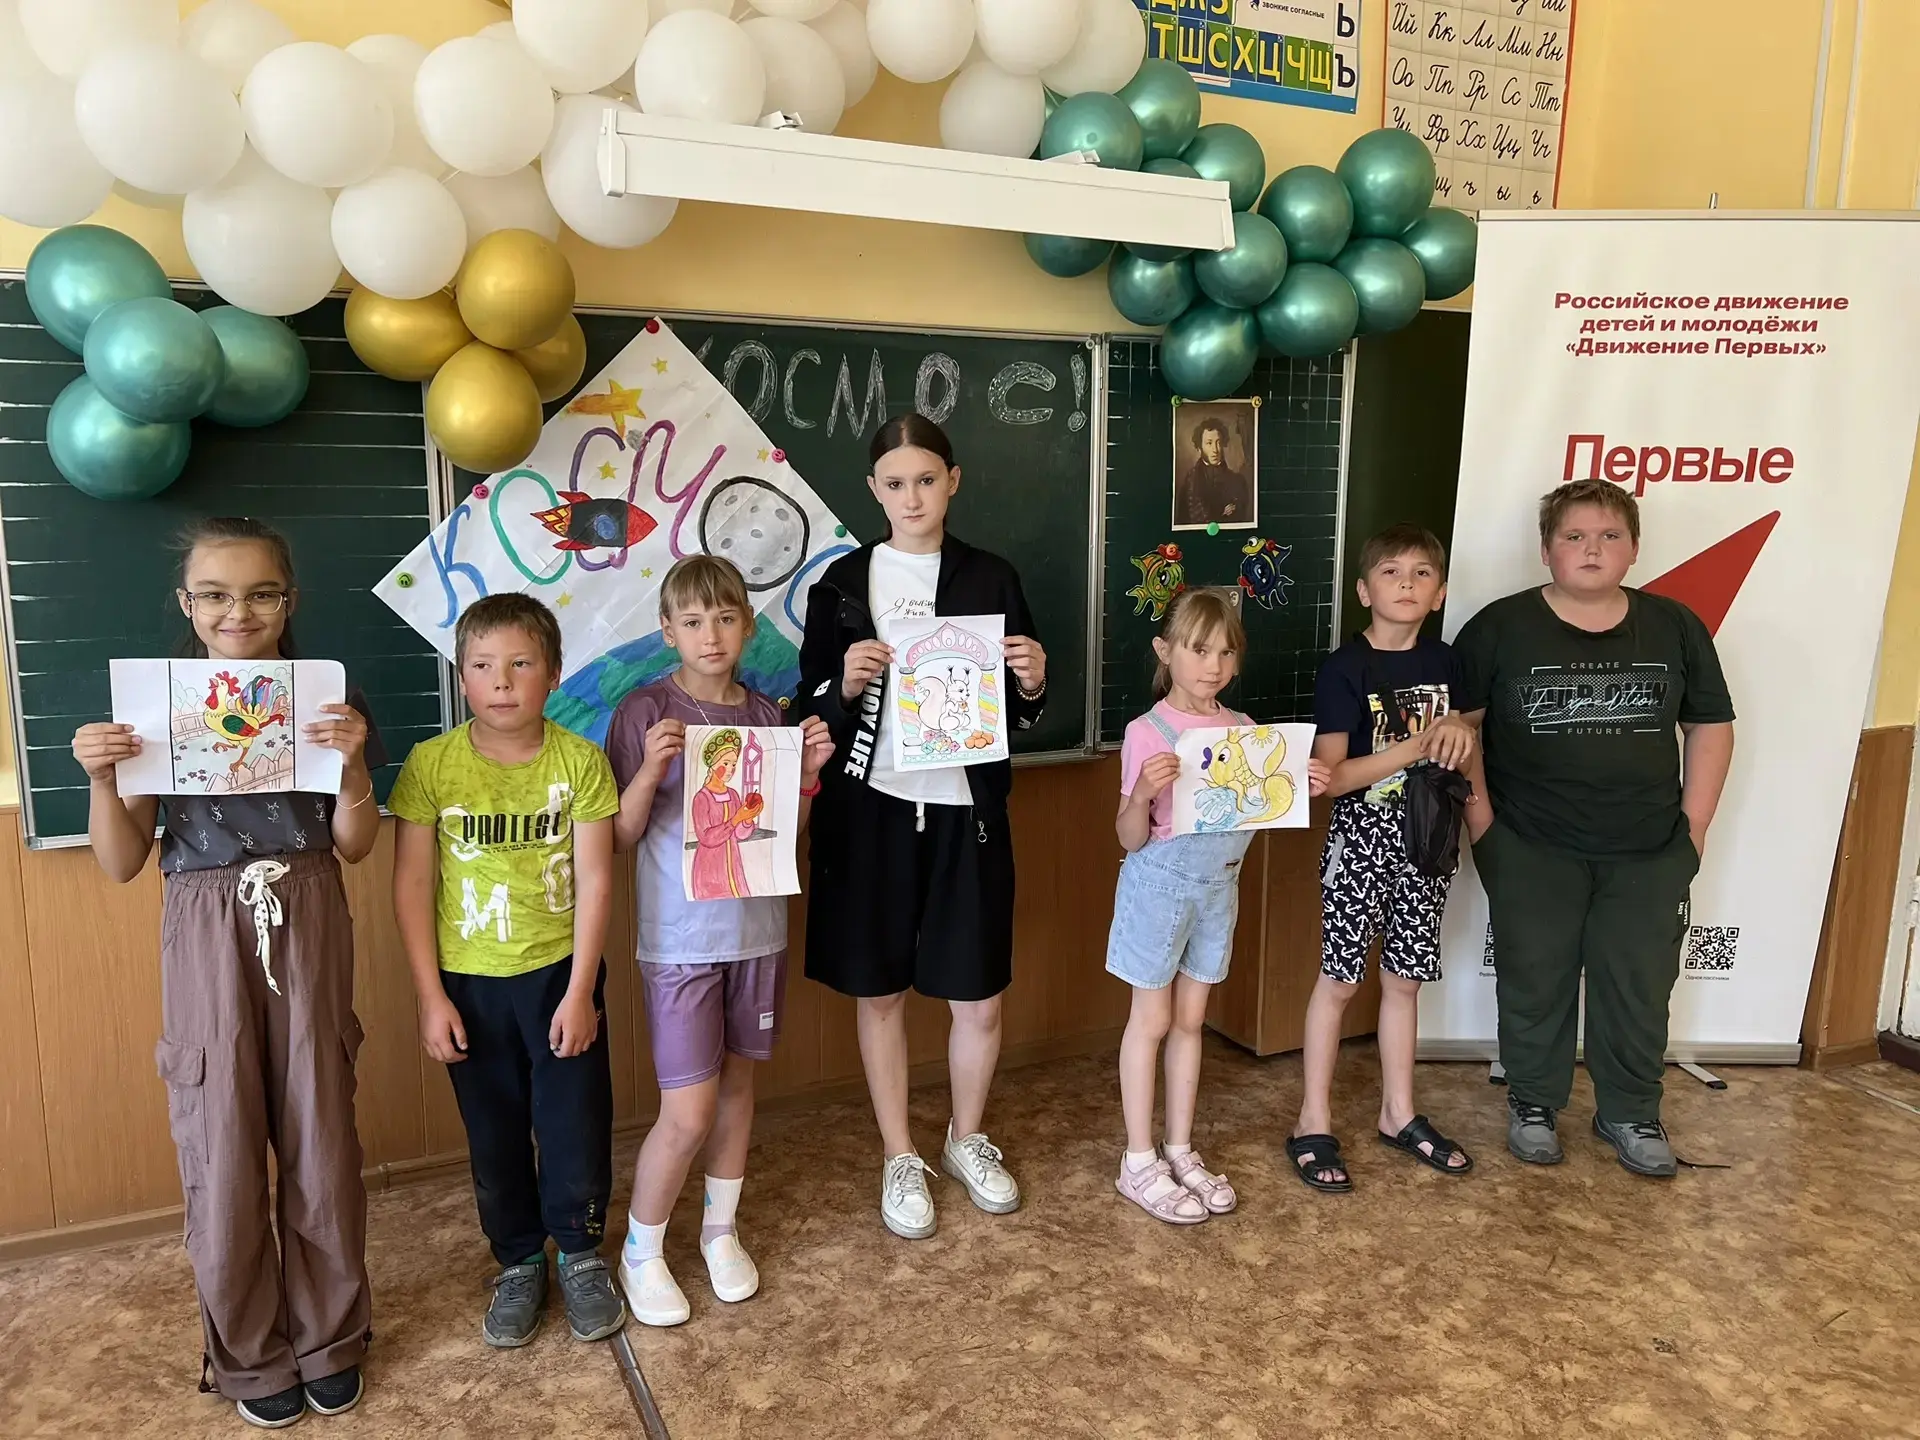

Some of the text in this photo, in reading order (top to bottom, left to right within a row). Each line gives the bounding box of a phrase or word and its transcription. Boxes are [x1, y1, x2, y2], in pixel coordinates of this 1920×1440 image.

[1262, 1, 1325, 19] ЗВОНКИЕ СОГЛАСНЫЕ
[1428, 11, 1456, 42] Кк
[1462, 19, 1495, 50] Лл
[1498, 25, 1532, 57] Мм
[1535, 31, 1564, 62] Нн
[1392, 57, 1561, 112] Оо Пп Рр Сс Тт
[1423, 113, 1450, 154] Фф
[1456, 119, 1487, 149] Хх
[1492, 123, 1522, 159] Цц
[1532, 129, 1551, 159] Чч
[1554, 292, 1849, 312] Российское движение
[1579, 314, 1818, 334] детей и молодёжи
[1565, 338, 1827, 358] «Движение Первых»
[696, 335, 1088, 440] ОСМОС!
[1563, 434, 1794, 498] Первые
[844, 729, 874, 780] LIFE
